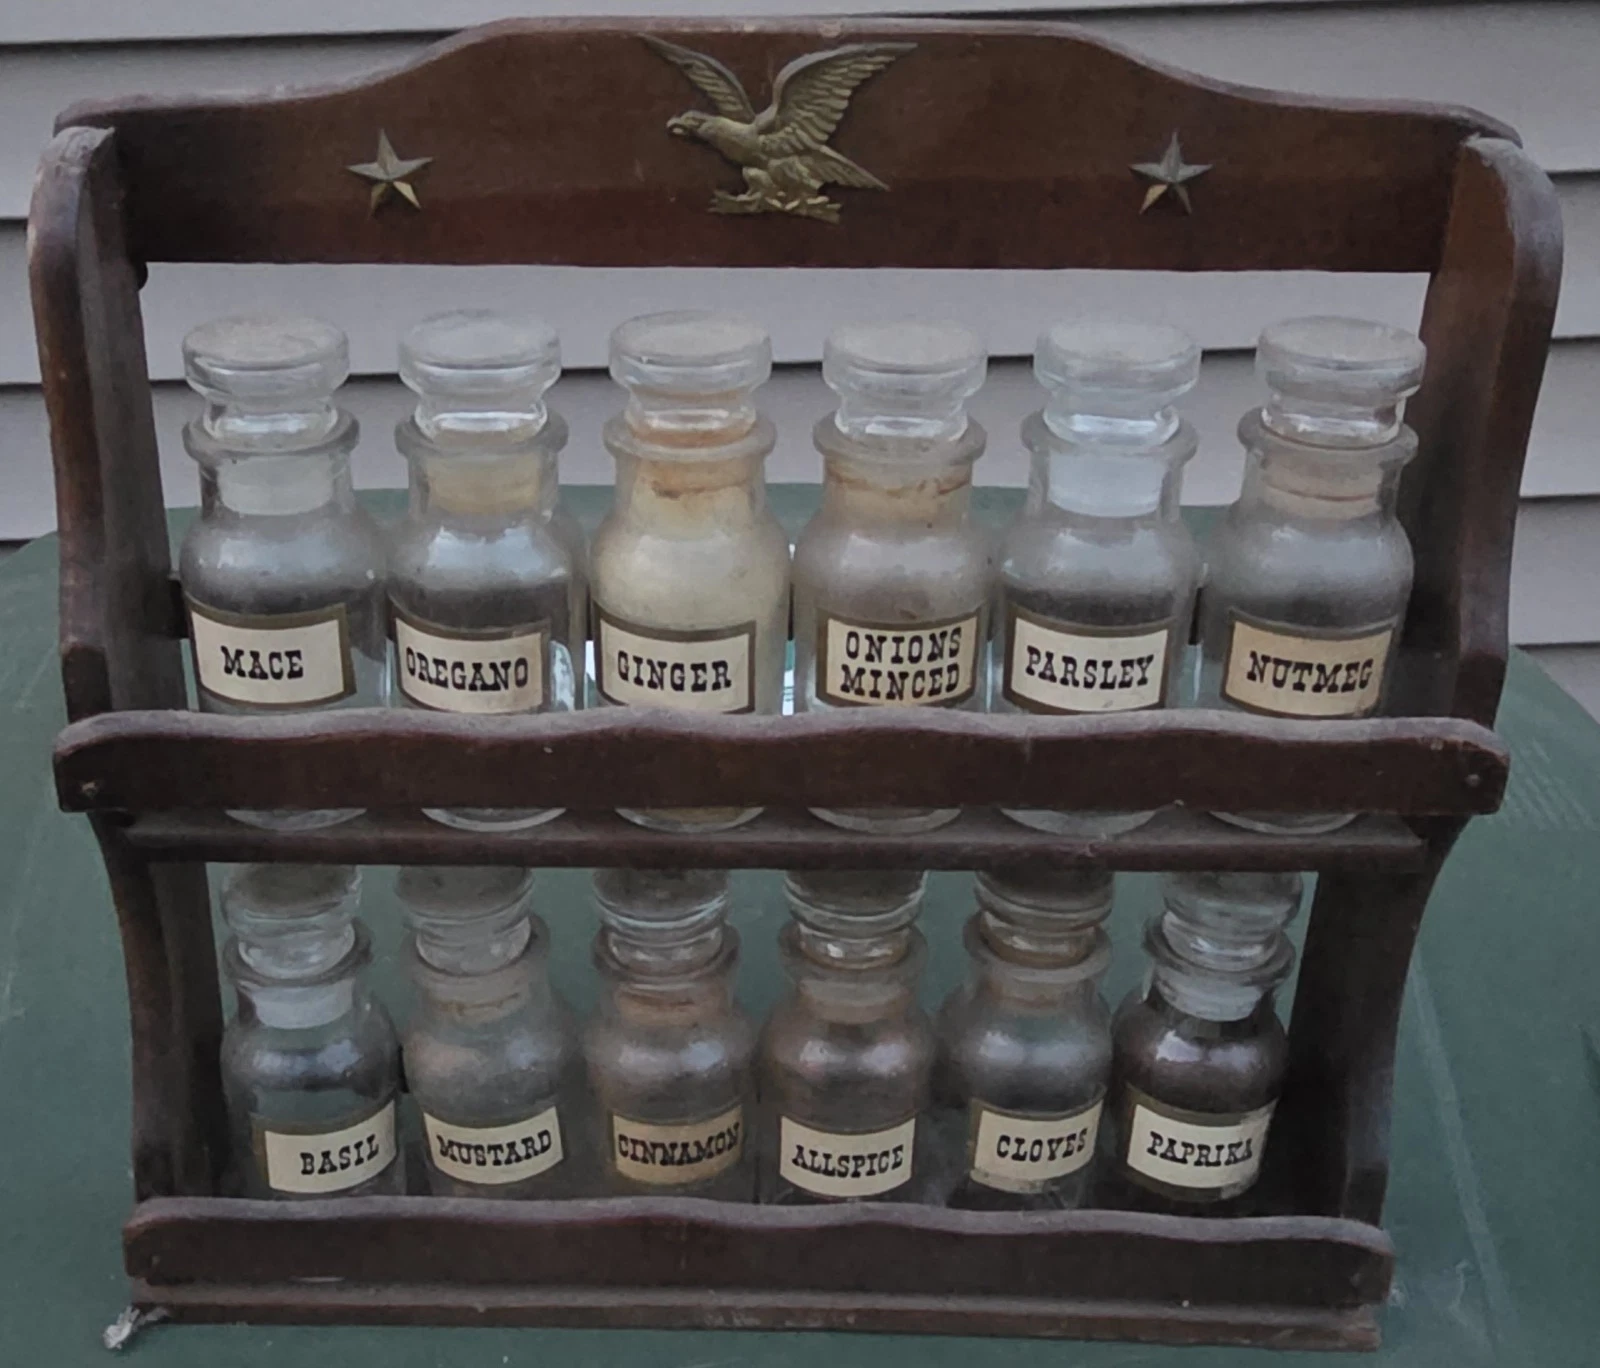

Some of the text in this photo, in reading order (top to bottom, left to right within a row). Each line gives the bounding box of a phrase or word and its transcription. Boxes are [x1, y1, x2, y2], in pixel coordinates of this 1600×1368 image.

[222, 646, 305, 680] MACE
[845, 626, 963, 665] ONIONS
[405, 646, 529, 691] OREGANO
[616, 651, 733, 692] GINGER
[840, 663, 960, 700] MINCED
[1025, 646, 1154, 690] PARSLEY
[1246, 650, 1373, 693] NUTMEG
[300, 1134, 379, 1175] BASIL
[436, 1129, 552, 1166] MUSTARD
[617, 1122, 742, 1167] CINNAMON
[792, 1144, 904, 1178] ALLSPICE
[996, 1127, 1088, 1162] CLOVES
[1147, 1131, 1253, 1167] PAPRIKA
